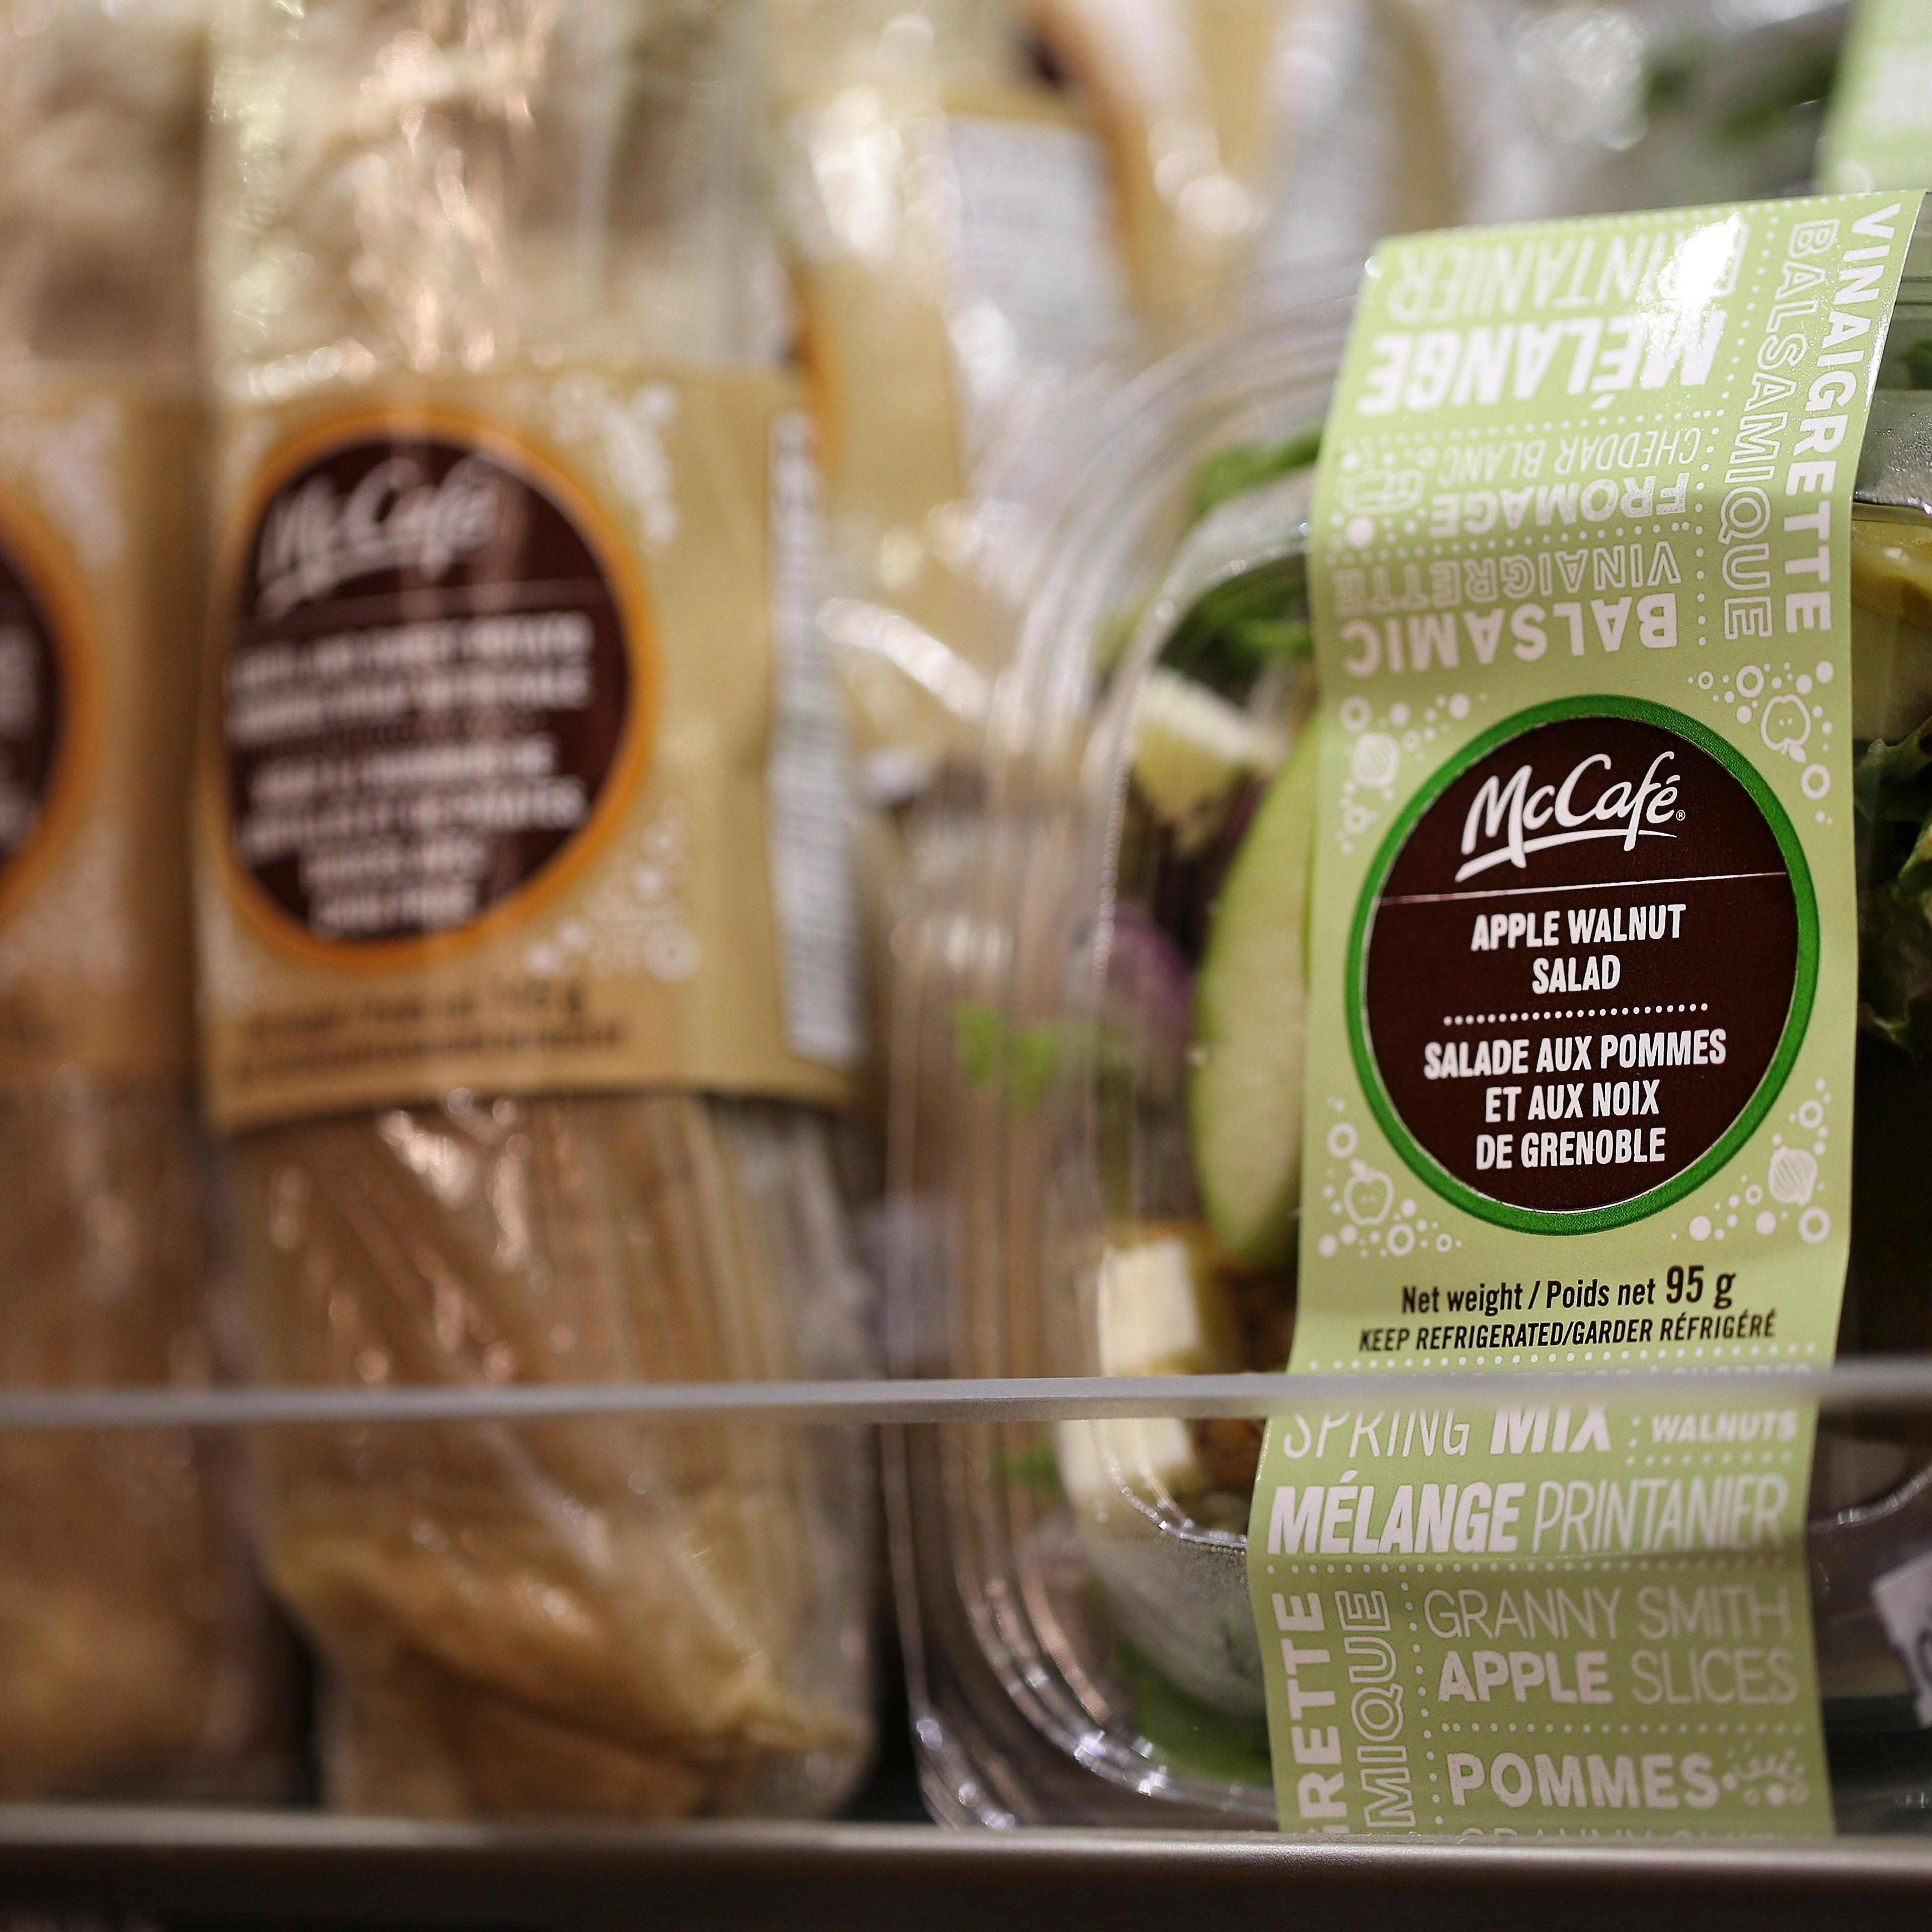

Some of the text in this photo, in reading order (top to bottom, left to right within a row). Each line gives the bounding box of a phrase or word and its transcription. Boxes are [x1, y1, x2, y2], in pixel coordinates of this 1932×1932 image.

[1356, 308, 1727, 416] MÉLANGE
[1718, 218, 1840, 640] BALSAMIQUE
[1784, 201, 1903, 632] VINAIGRETTE
[1437, 426, 1703, 487] CHEDDAR BLANC
[1429, 472, 1691, 538] FROMAGE
[1331, 540, 1682, 616] VINAIGRETTE
[1341, 592, 1678, 677] BALSAMIC
[1470, 904, 1686, 951] APPLE WALNUT
[1532, 954, 1621, 995] SALAD
[1423, 1028, 1727, 1080] SALADE AUX POMMES
[1485, 1079, 1660, 1123] ET AUX NOIX
[1476, 1126, 1667, 1171] DE GRENOBLE
[1401, 1264, 1737, 1318] Net weight / Poids net 95 g
[1358, 1311, 1778, 1353] KEEP REFRIGERATED/GARDER RÉFRIGÉRÉ
[1283, 1404, 1612, 1458] SPRING MIX
[1651, 1409, 1799, 1443] WALNUTS
[1266, 1470, 1791, 1556] MÉLANGE PRINTANIER
[1423, 1583, 1792, 1641] GRANNY SMITH
[1437, 1648, 1800, 1707] APPLE SLICES
[1271, 1590, 1350, 1833] RETTE
[1445, 1752, 1716, 1810] POMMES
